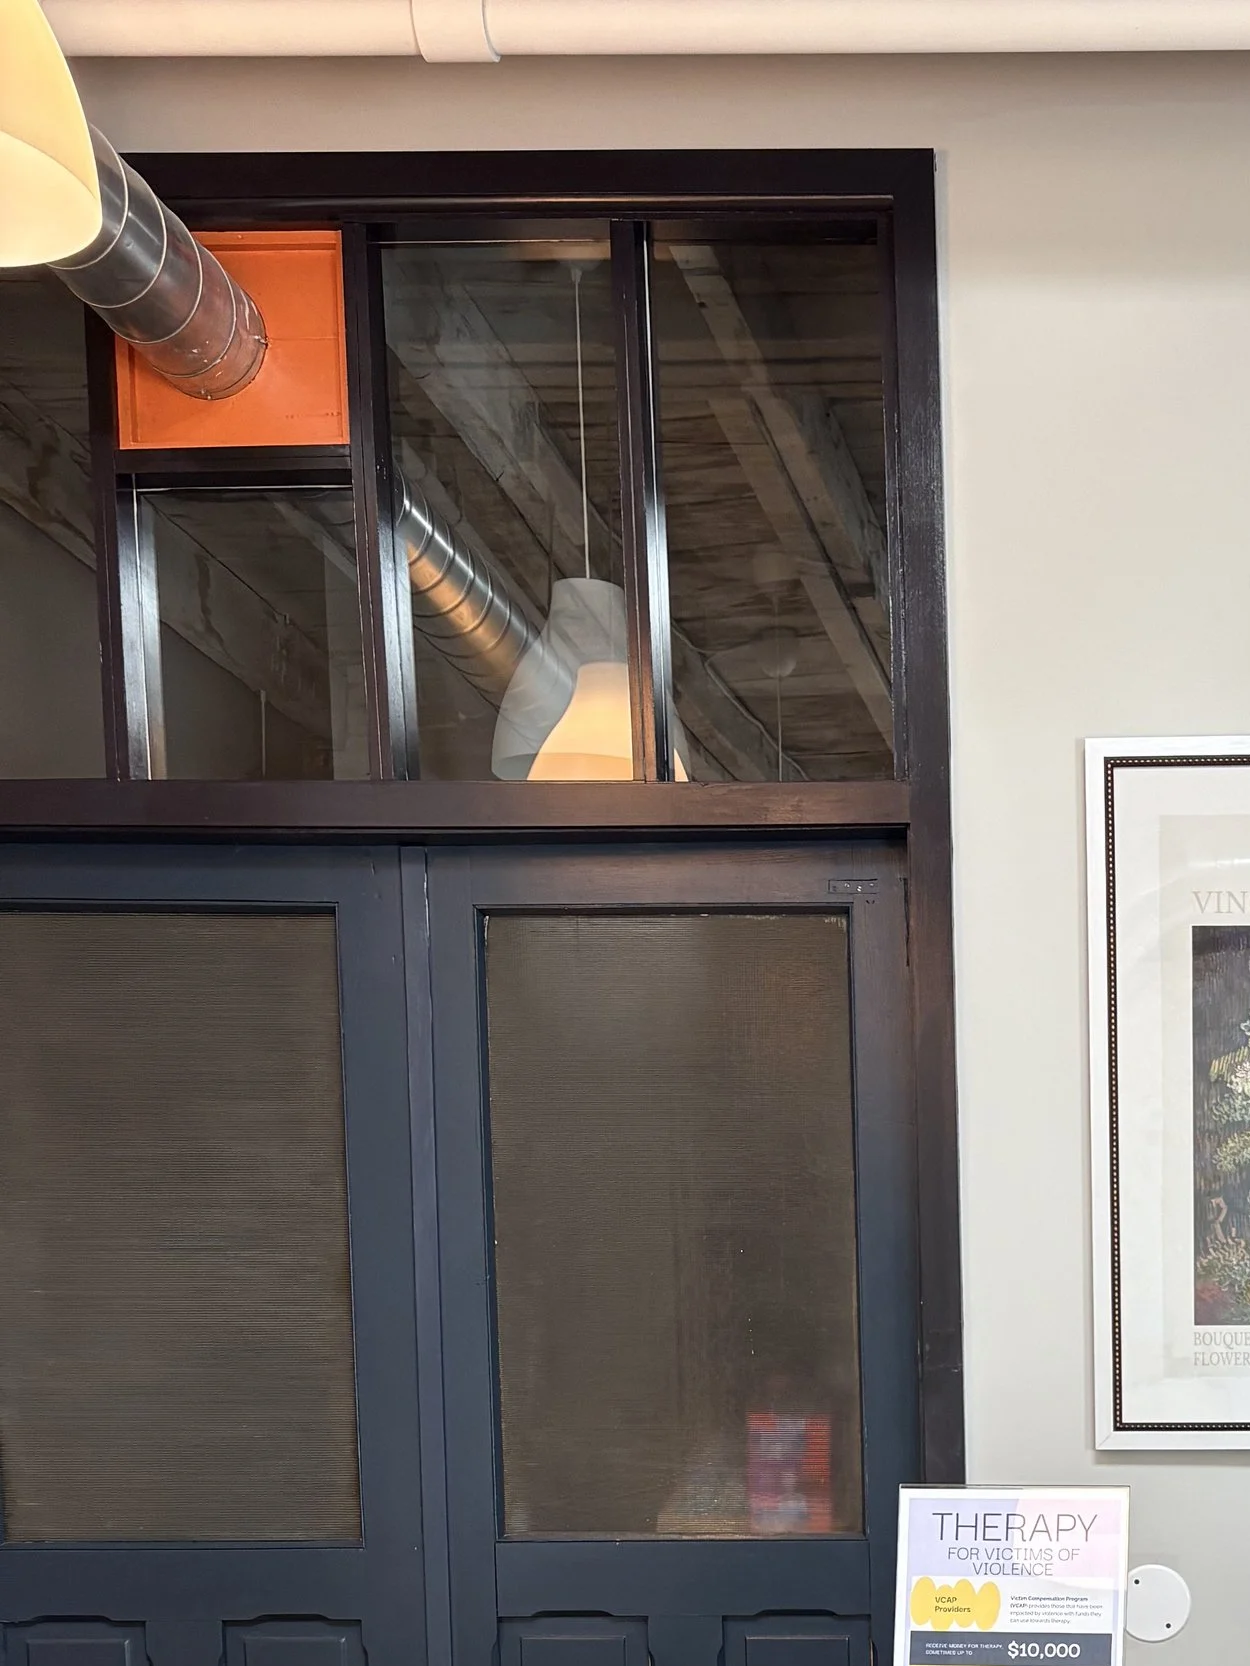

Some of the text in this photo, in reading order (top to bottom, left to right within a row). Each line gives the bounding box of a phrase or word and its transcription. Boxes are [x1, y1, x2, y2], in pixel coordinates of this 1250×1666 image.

[932, 1512, 1098, 1542] THERAPY
[948, 1547, 1080, 1562] FOR VICTIMS OF
[972, 1562, 1054, 1576] VIOLENCE
[1008, 1640, 1080, 1659] $10,000
